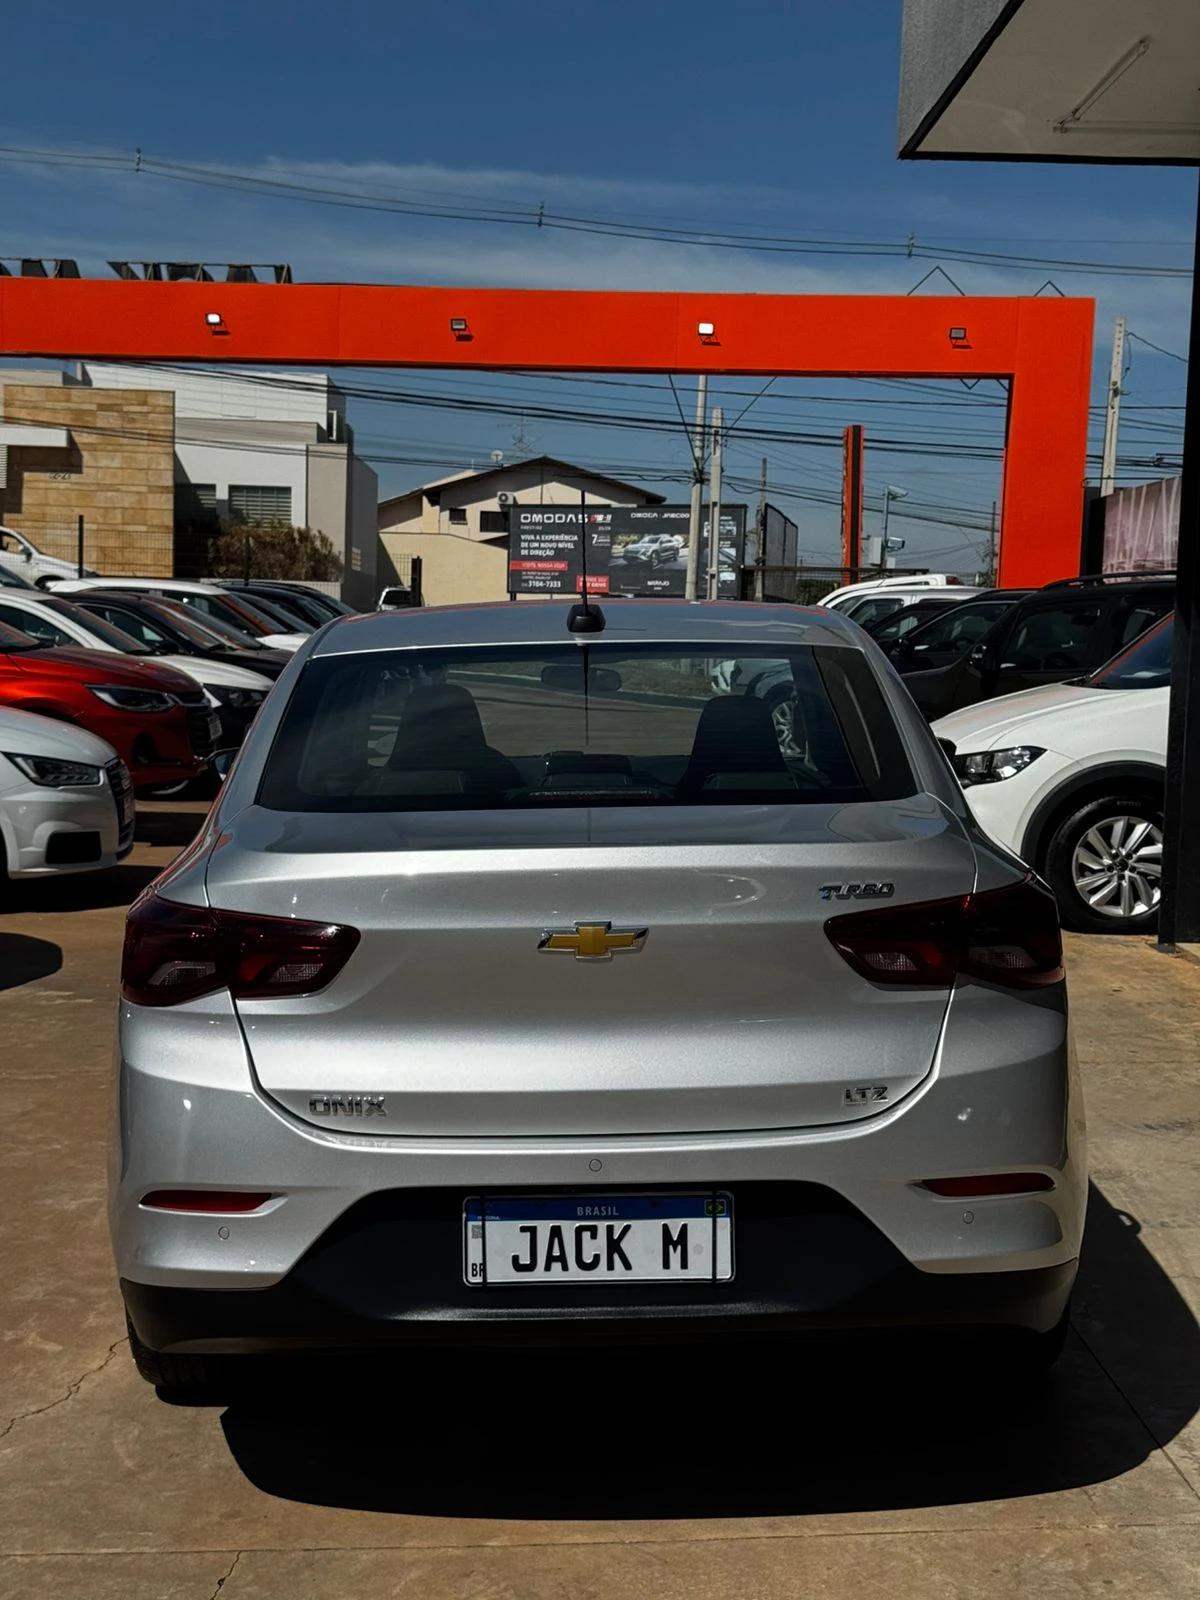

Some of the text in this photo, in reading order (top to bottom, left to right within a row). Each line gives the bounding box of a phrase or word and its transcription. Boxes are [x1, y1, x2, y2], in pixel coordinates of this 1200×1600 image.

[520, 513, 576, 523] OMODA
[541, 533, 578, 541] EXPERIÊNCIA
[844, 1086, 889, 1104] LTZ
[308, 1095, 388, 1117] ONIX
[576, 1206, 620, 1216] BRASIL
[511, 1222, 689, 1273] JACK M
